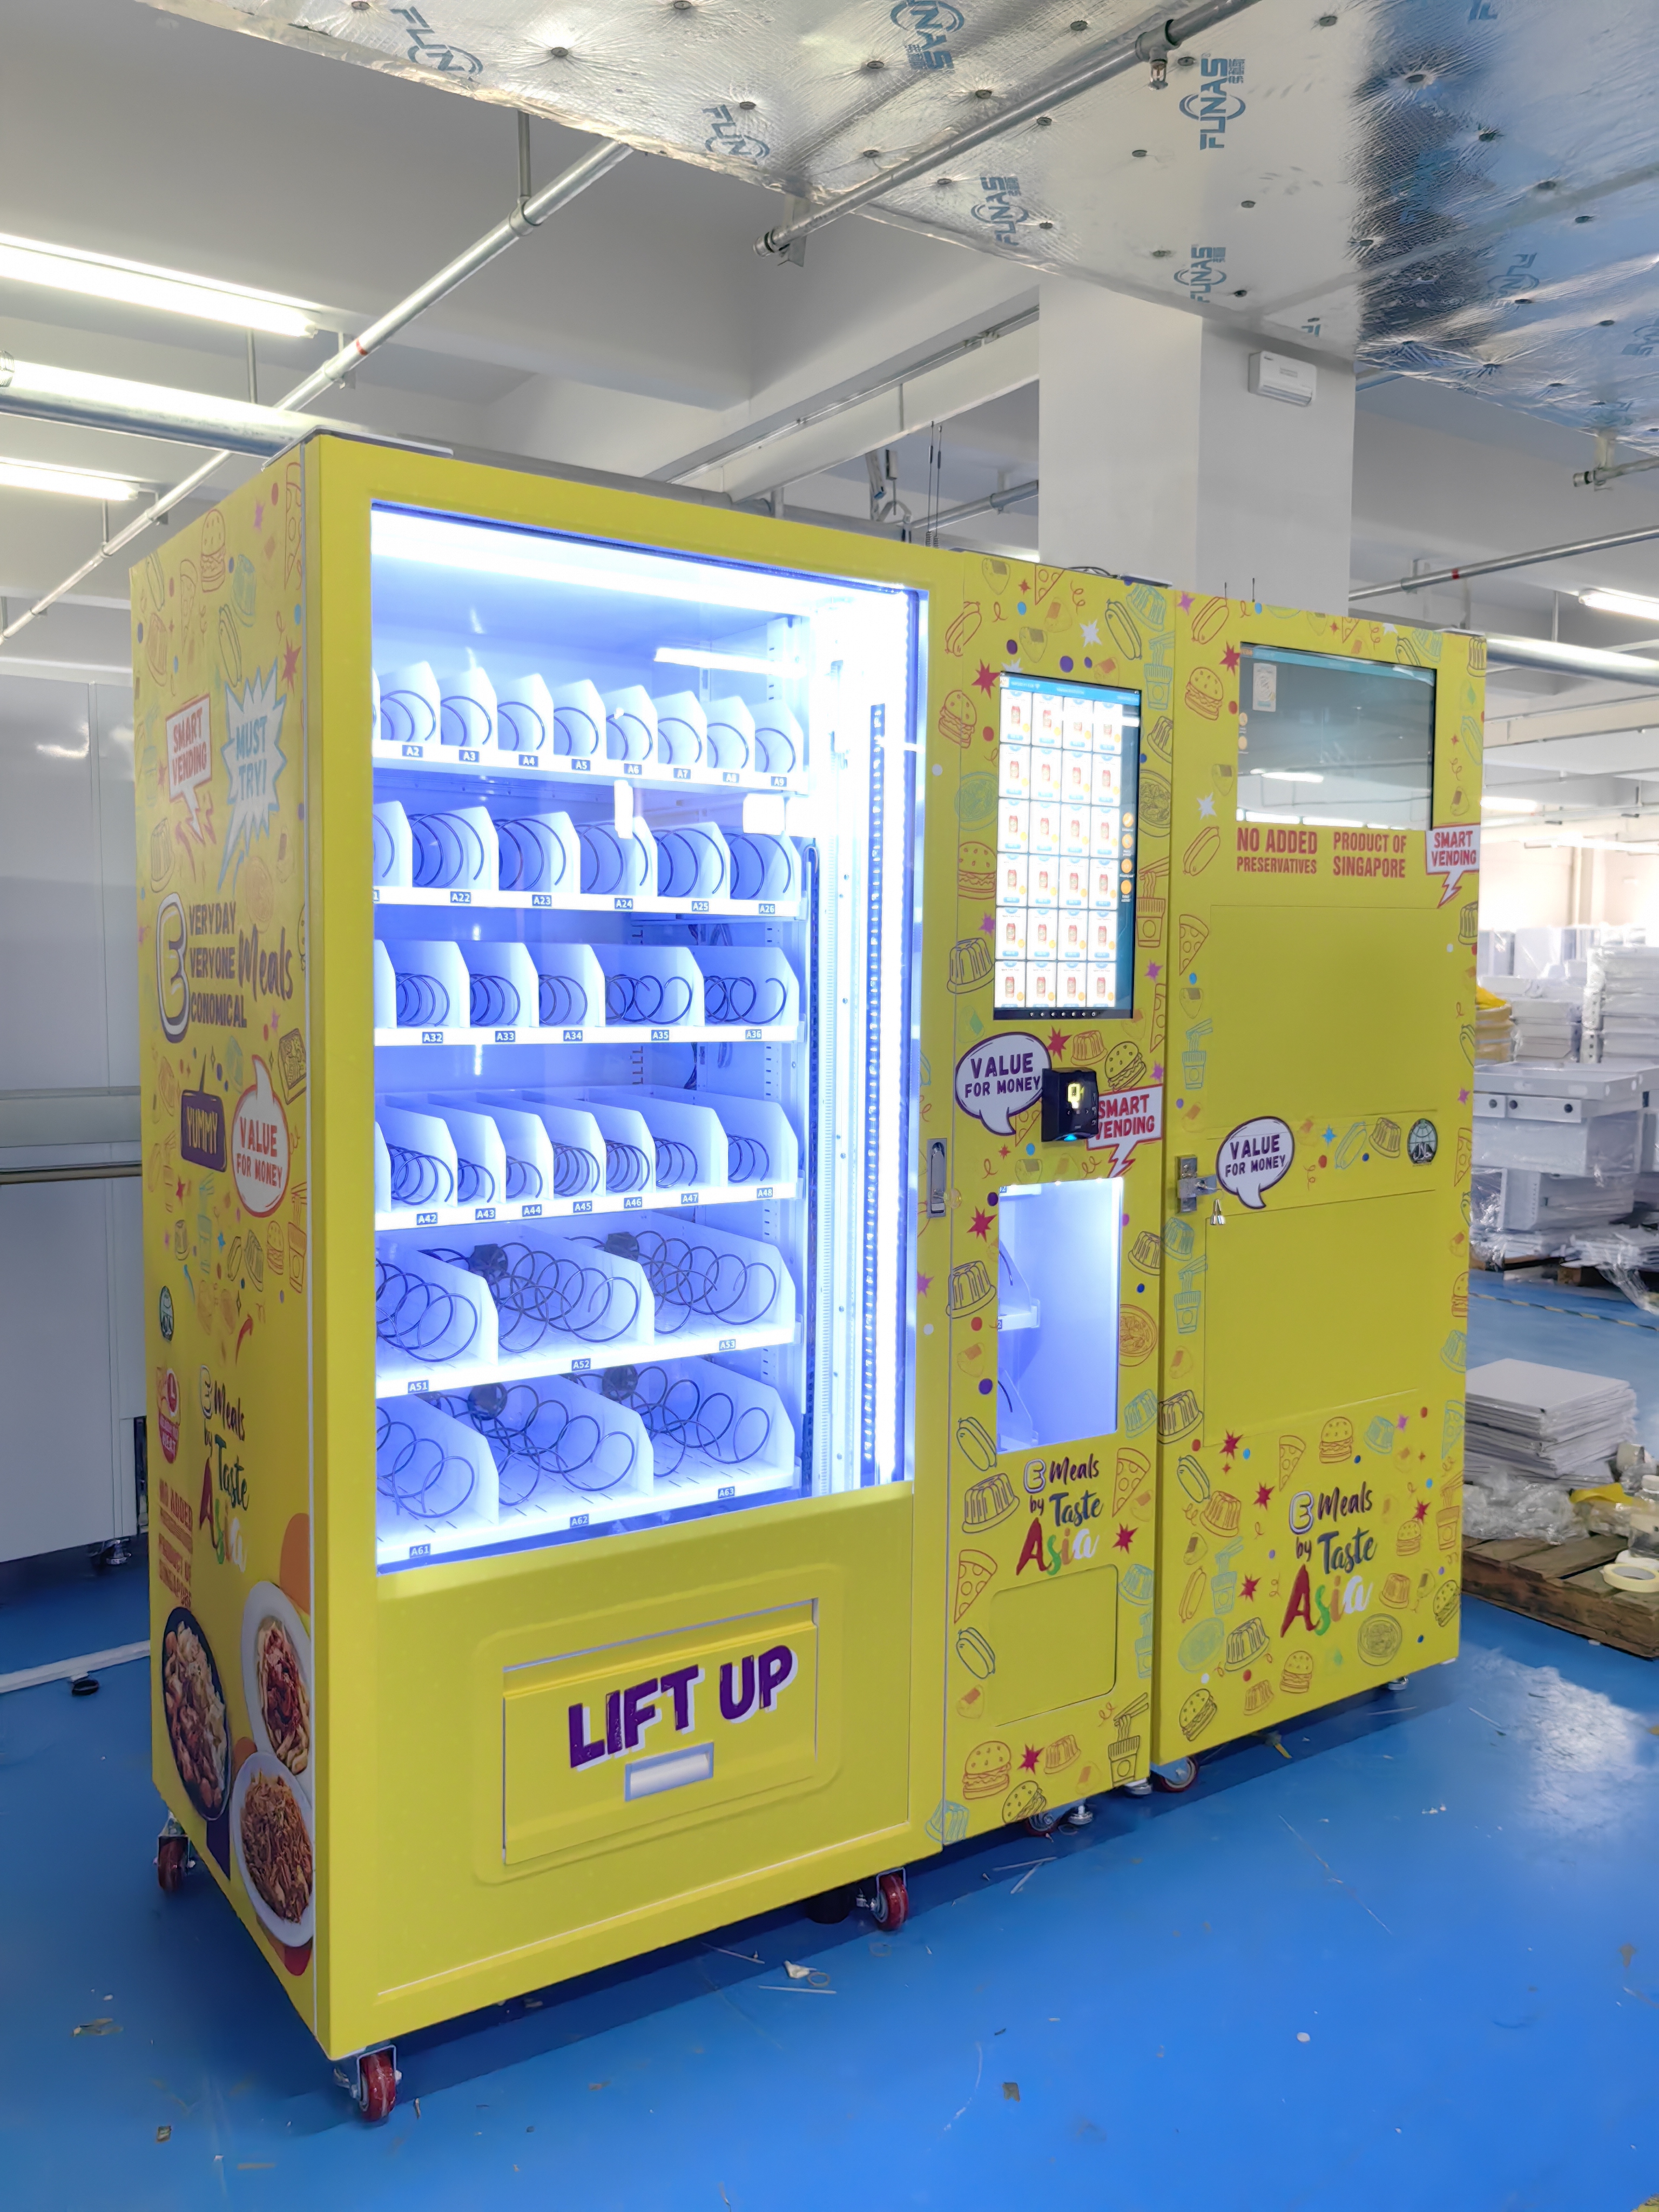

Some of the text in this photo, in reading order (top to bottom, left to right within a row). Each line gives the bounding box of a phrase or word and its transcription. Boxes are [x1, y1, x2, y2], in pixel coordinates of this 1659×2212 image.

[173, 706, 203, 753] SMART
[236, 715, 268, 760] MUST
[406, 746, 420, 756] A2
[463, 752, 476, 761] A3
[172, 741, 207, 786] VENDING
[523, 757, 535, 765] A4
[576, 761, 588, 770] A5
[628, 765, 639, 774] A6
[238, 759, 267, 801] TRY!
[677, 770, 688, 778] A7
[774, 778, 784, 786] A9
[1237, 827, 1318, 855] NO ADDED
[1333, 832, 1407, 854] PRODUCT OF
[1434, 831, 1473, 848] SMART
[1431, 848, 1476, 866] VENDING
[1237, 857, 1317, 875] PRESERVATIVES
[1333, 857, 1406, 879] SINGAPORE
[451, 893, 470, 902] A22
[533, 896, 551, 905] A23
[616, 899, 632, 908] A24
[693, 902, 709, 911] A25
[759, 905, 774, 913] A26
[189, 901, 236, 936] VERYDAY
[190, 923, 293, 1002] VERYONE Meals
[191, 992, 247, 1028] CONOMICAL
[423, 1033, 442, 1042] A32
[496, 1031, 515, 1041] A33
[564, 1031, 582, 1040] A34
[652, 1030, 669, 1040] A35
[746, 1030, 761, 1038] A36
[970, 1053, 1033, 1079] VALUE
[965, 1075, 1041, 1098] FOR MONEY
[1099, 1094, 1150, 1119] SMART
[185, 1106, 218, 1155] YUMMY
[239, 1116, 278, 1157] VALUE
[1229, 1134, 1280, 1160] VALUE
[236, 1153, 283, 1189] FOR MONEY
[1225, 1154, 1286, 1177] FOR MONEY
[682, 1193, 698, 1202] A47
[758, 1189, 773, 1197] A48
[523, 1205, 542, 1215] A44
[574, 1202, 592, 1211] A45
[625, 1198, 642, 1207] A46
[417, 1213, 437, 1224] A42
[476, 1209, 495, 1219] A43
[720, 1340, 736, 1349] A53
[572, 1359, 590, 1369] A52
[409, 1381, 428, 1392] A51
[214, 1380, 245, 1442] Meals
[204, 1418, 249, 1512] by Taste
[1049, 1453, 1100, 1485] Meals
[719, 1488, 734, 1496] A63
[1029, 1489, 1104, 1527] by Taste
[1317, 1480, 1373, 1522] Meals
[199, 1457, 248, 1573] Asia
[571, 1515, 589, 1525] A62
[411, 1546, 429, 1556] A61
[1016, 1516, 1100, 1576] Asia
[1296, 1527, 1378, 1575] by Taste
[1280, 1563, 1374, 1638] Asia
[569, 1645, 796, 1770] LIFT UP
